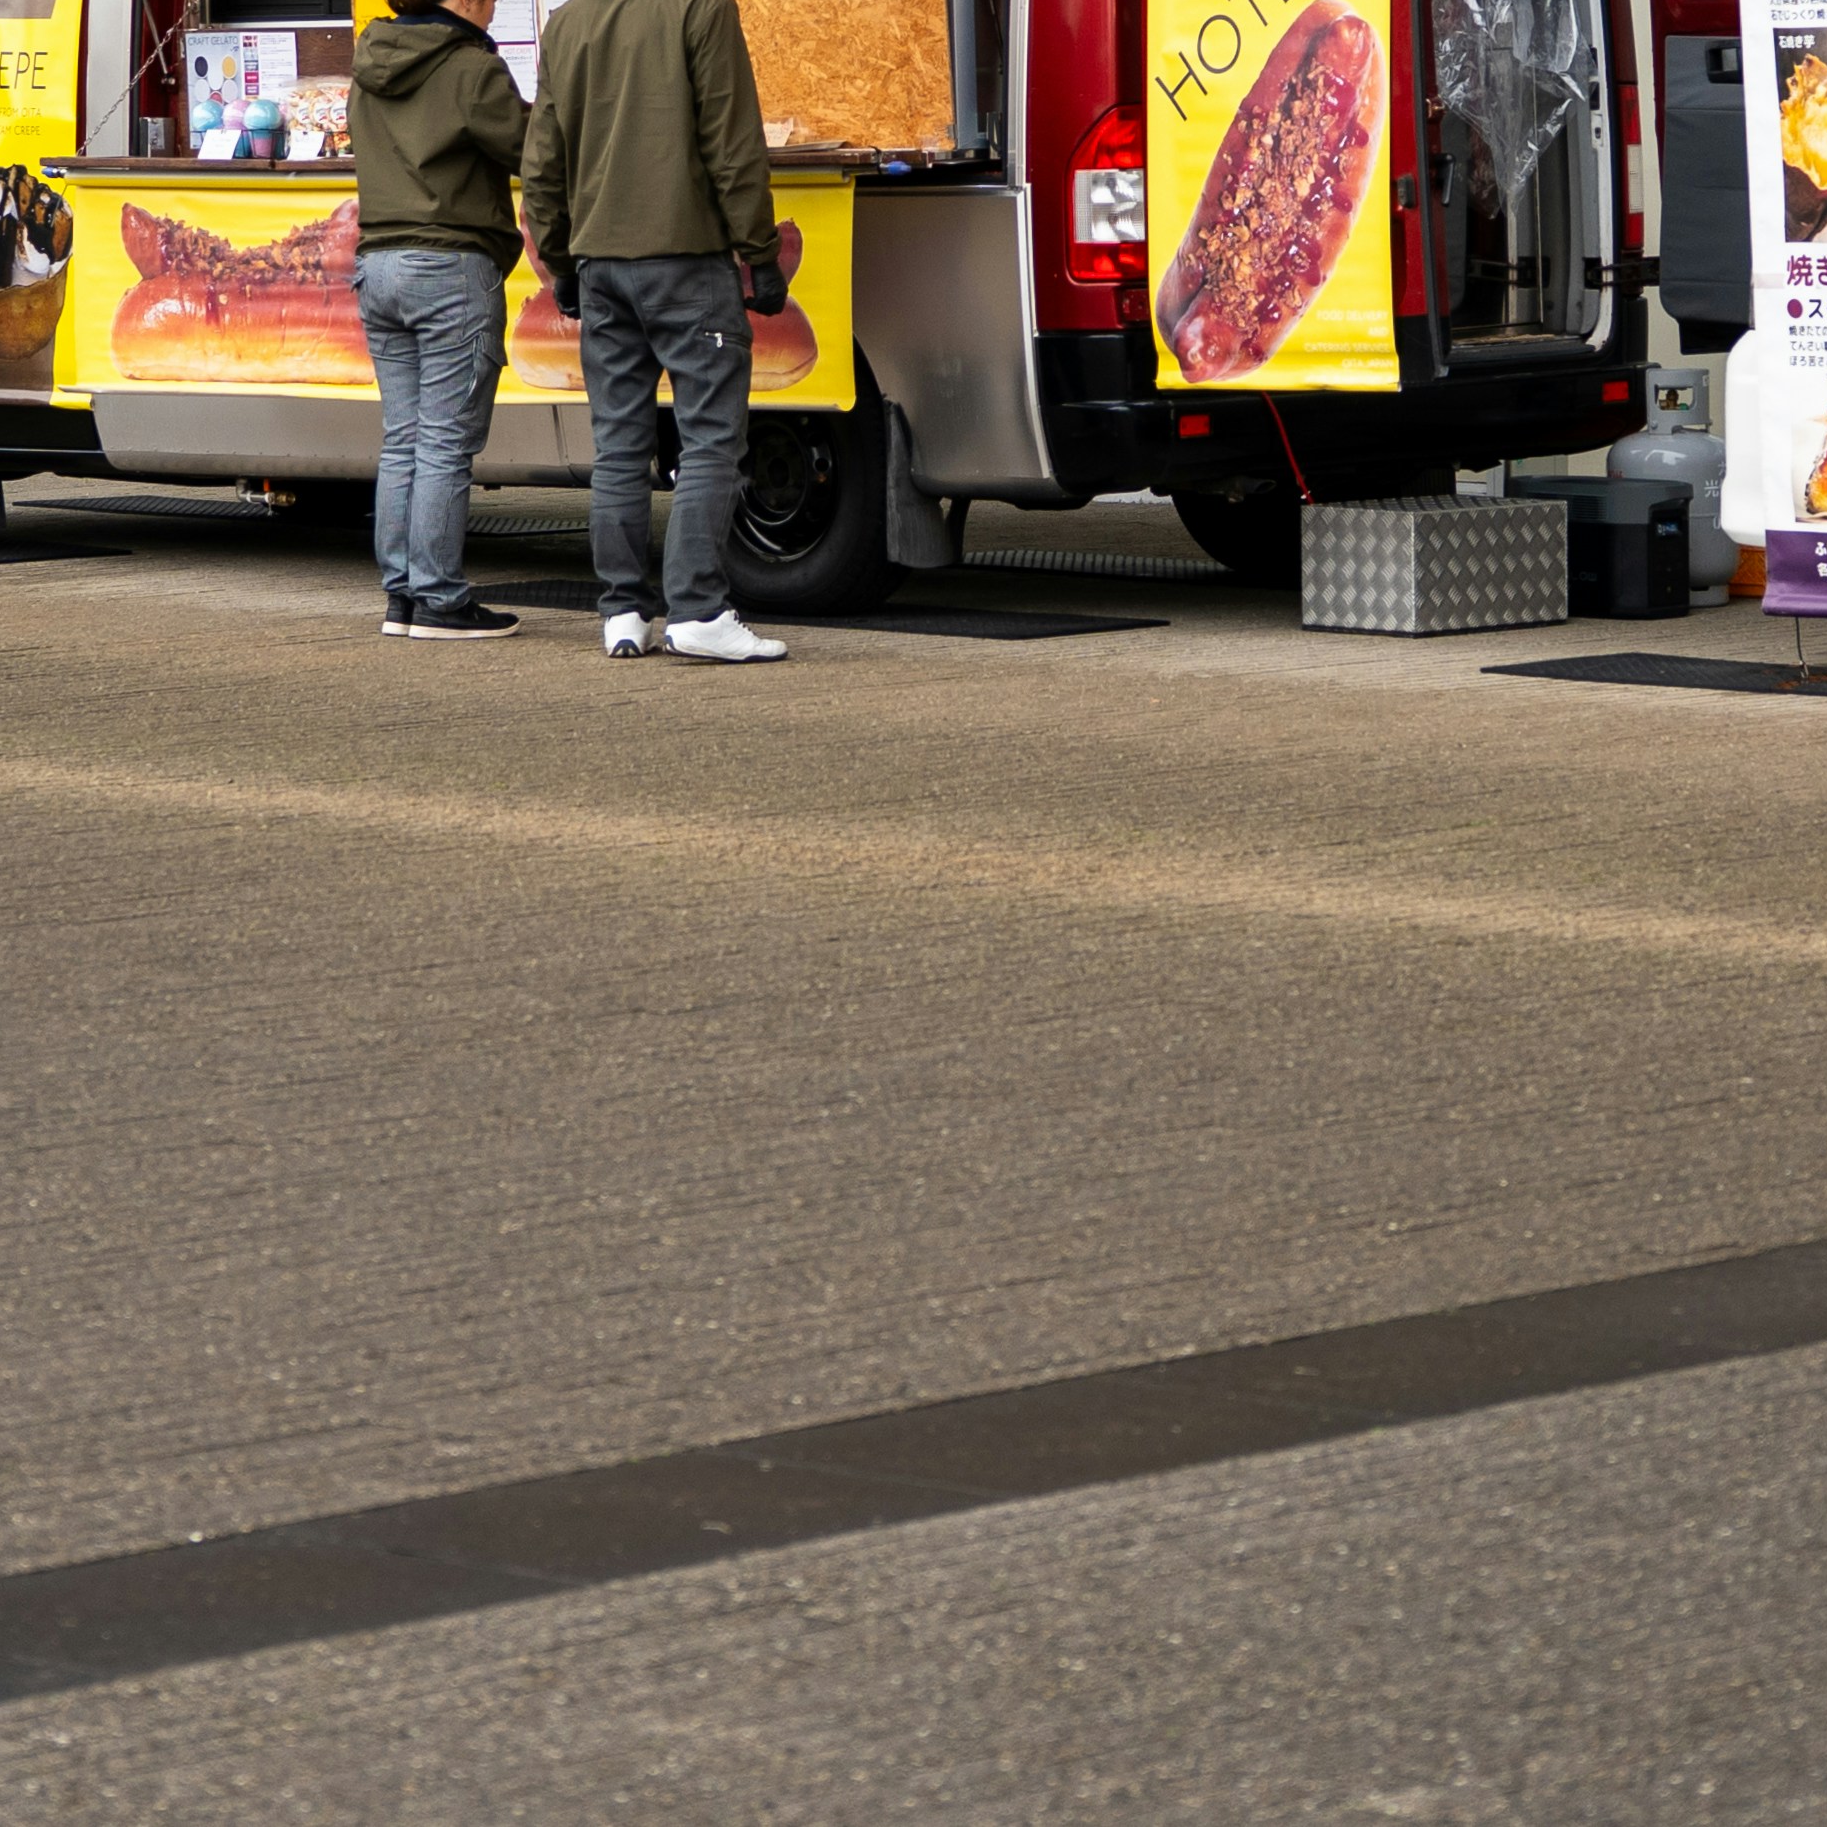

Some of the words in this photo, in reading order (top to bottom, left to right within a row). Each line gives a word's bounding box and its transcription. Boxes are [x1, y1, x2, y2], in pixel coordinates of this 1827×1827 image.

[187, 34, 209, 47] CRAFT
[209, 35, 238, 46] GELATO
[13, 125, 42, 136] CREPE
